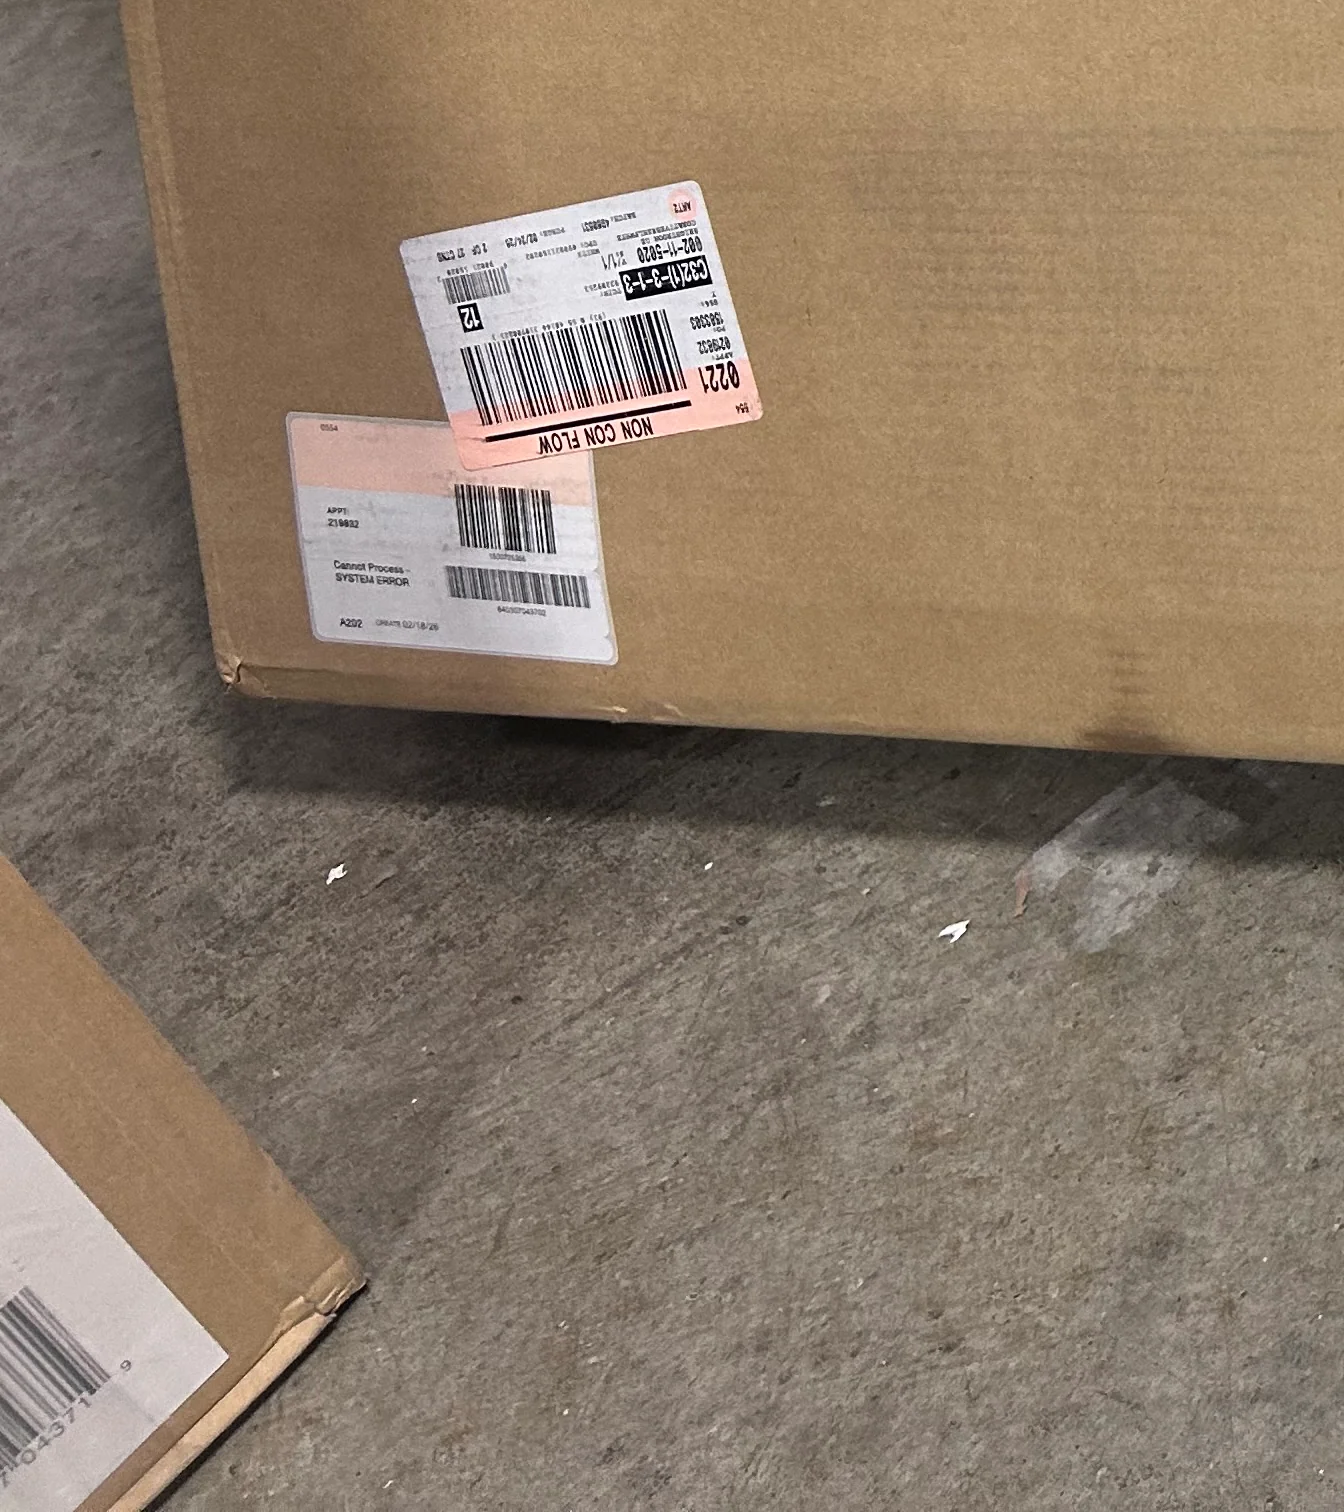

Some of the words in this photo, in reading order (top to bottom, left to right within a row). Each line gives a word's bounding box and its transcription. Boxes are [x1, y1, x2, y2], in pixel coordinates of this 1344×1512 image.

[635, 234, 703, 263] 002-11-5020
[459, 303, 480, 331] 12
[697, 359, 740, 394] 0221
[582, 422, 616, 446] CON
[619, 415, 654, 439] NON
[537, 429, 580, 455] FLOW
[332, 559, 366, 571] Cannot
[366, 562, 405, 574] Process
[334, 572, 375, 584] SYSTEM
[375, 575, 410, 587] ERROR
[119, 1358, 133, 1373] 9
